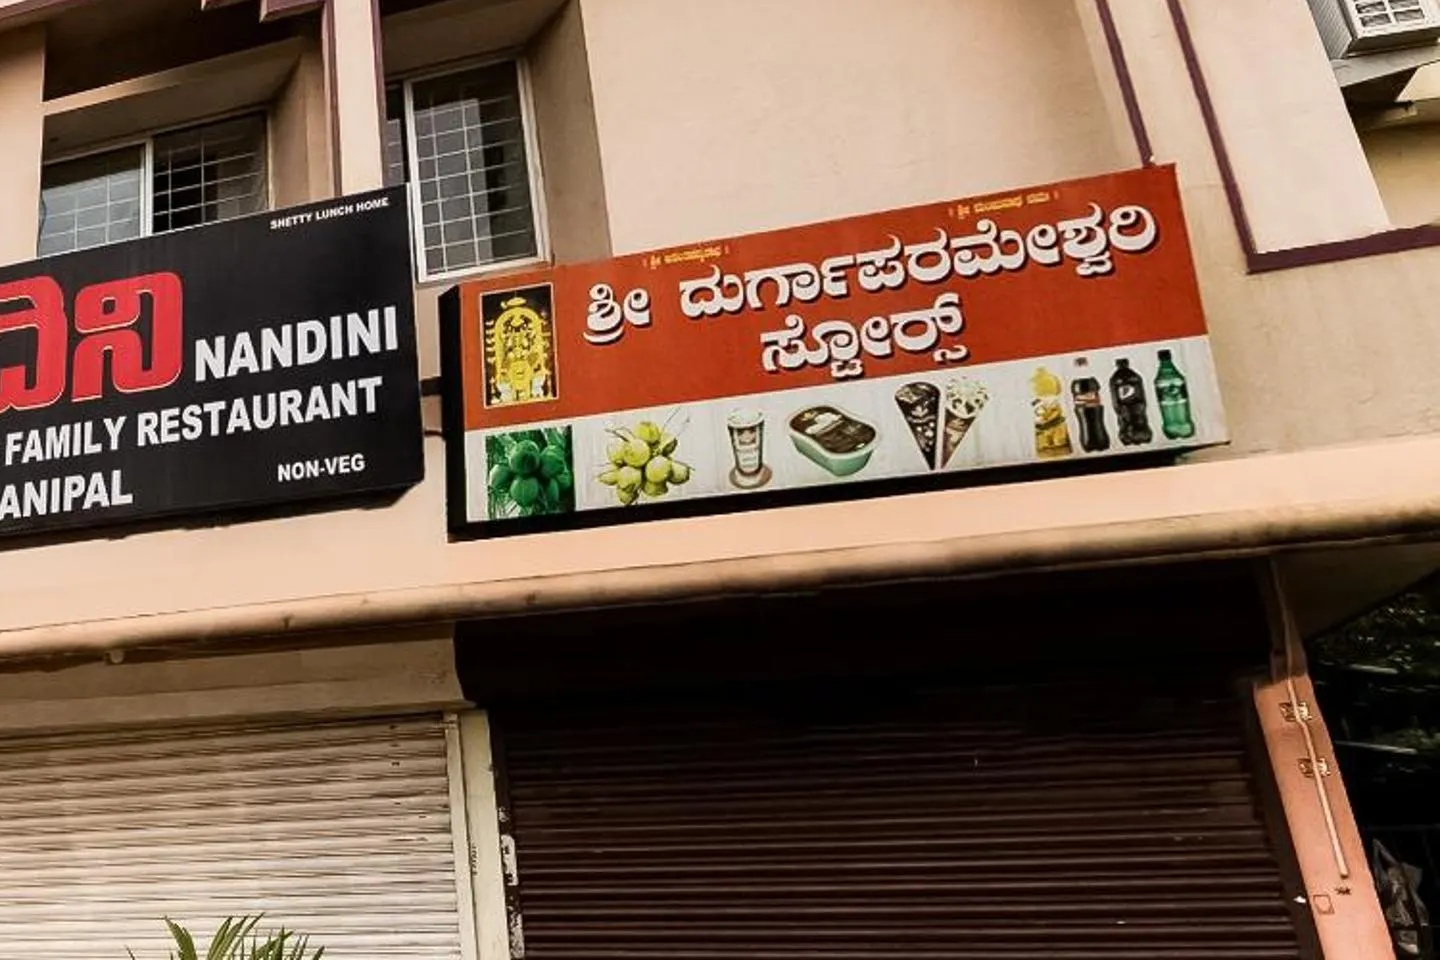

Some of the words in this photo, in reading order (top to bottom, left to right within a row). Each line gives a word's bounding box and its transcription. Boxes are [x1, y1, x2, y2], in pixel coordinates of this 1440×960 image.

[270, 214, 312, 230] SHETTY
[316, 205, 354, 221] LUNCH
[356, 197, 389, 212] HOME
[583, 283, 651, 344] ಶ್ರೀ
[679, 201, 1157, 318] ದುರ್ಗಾಪರಮೇಶ್ವರಿ
[194, 306, 398, 382] NANDINI
[5, 415, 127, 466] FAMILY
[137, 375, 383, 447] RESTAURANT
[277, 453, 366, 482] NON-VEG
